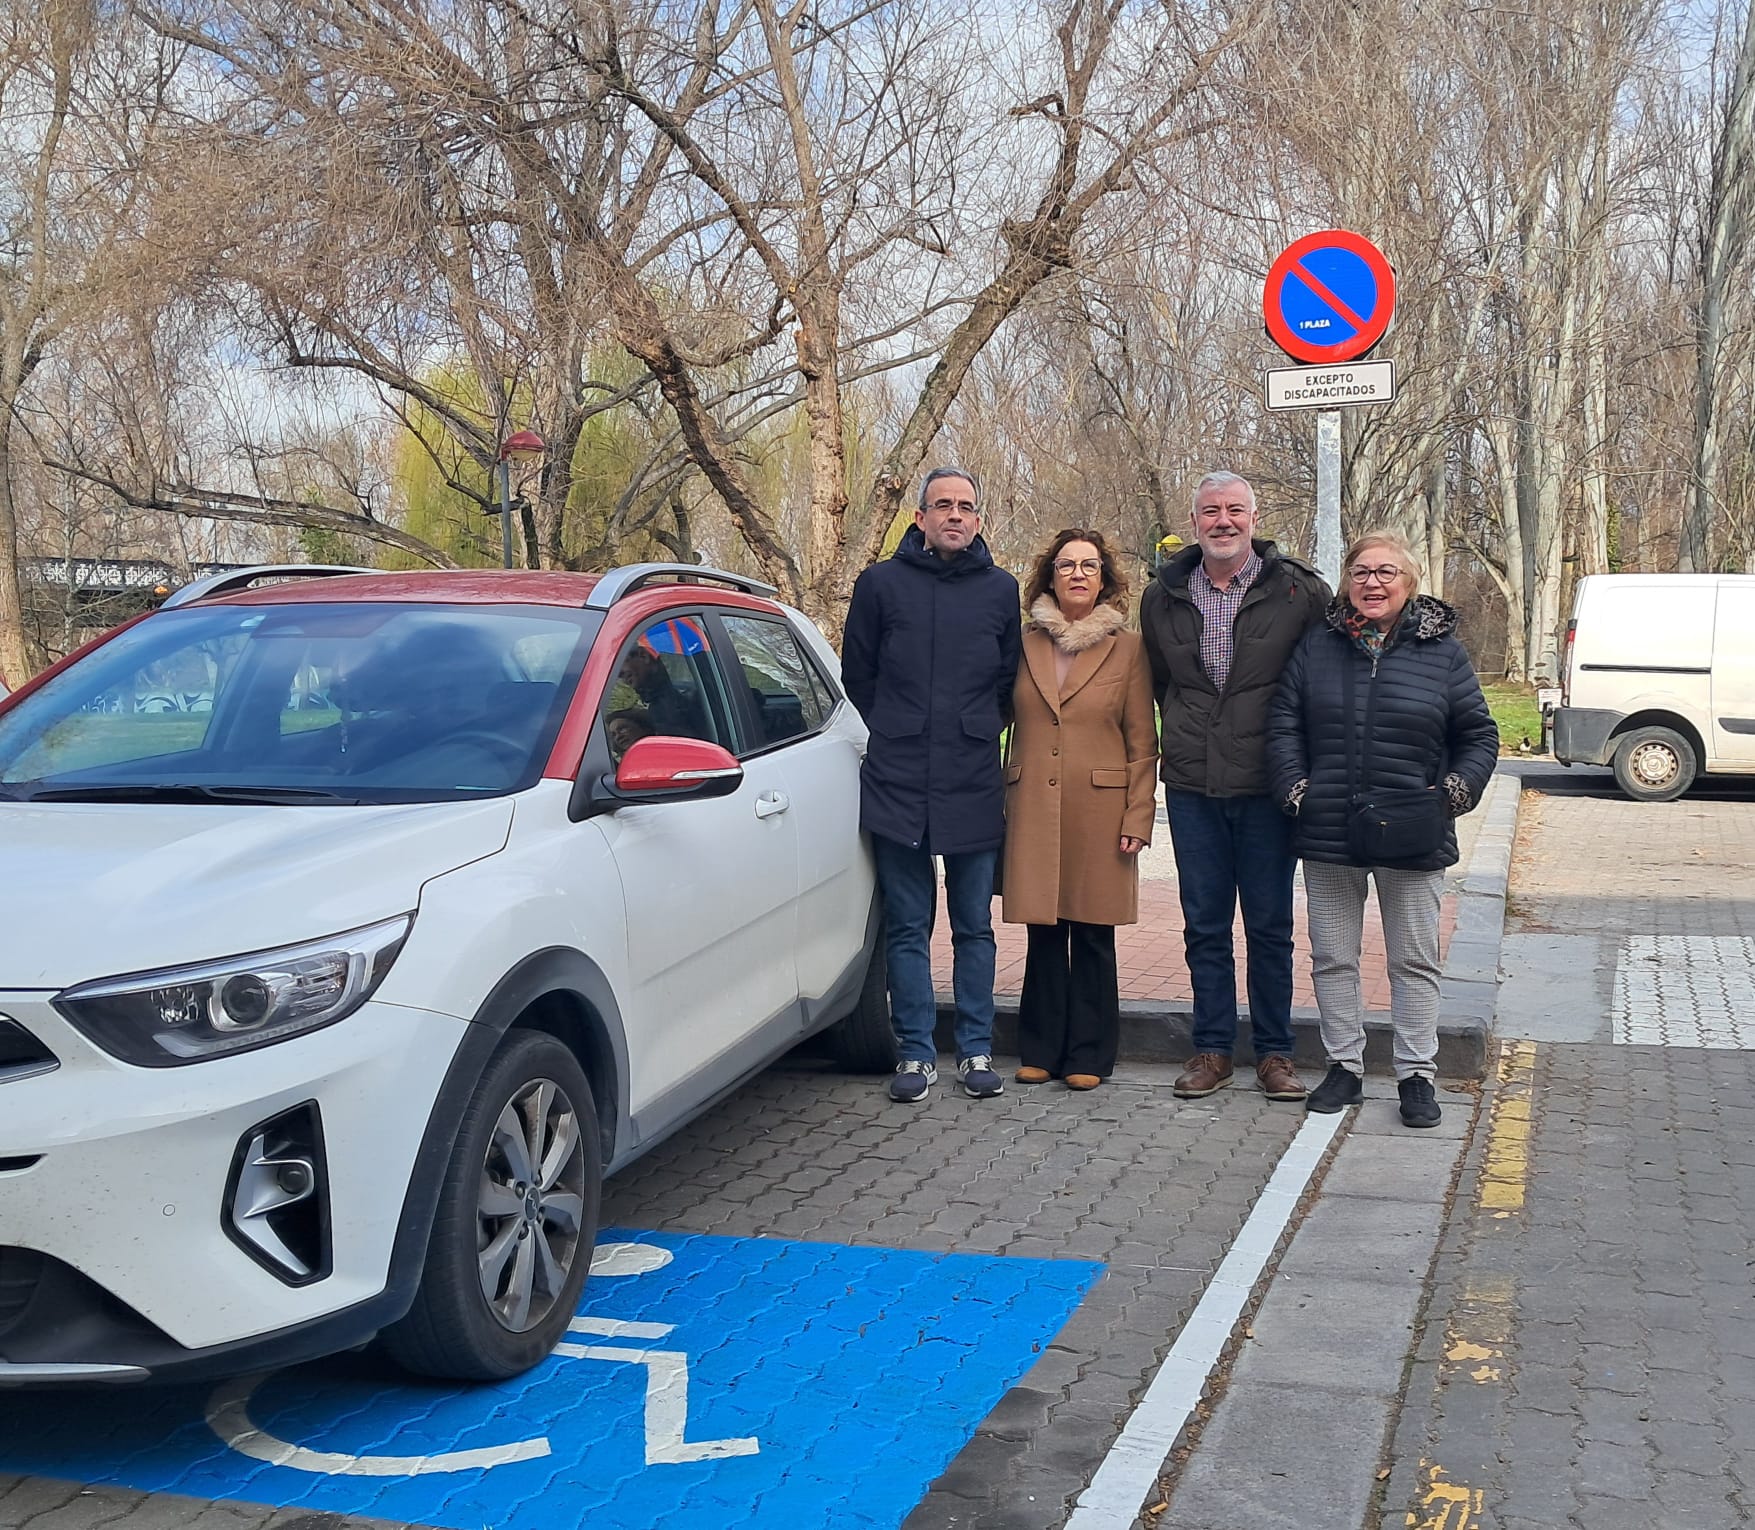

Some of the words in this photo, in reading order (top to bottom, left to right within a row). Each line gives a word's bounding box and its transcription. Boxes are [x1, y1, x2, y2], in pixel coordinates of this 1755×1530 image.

[1305, 319, 1331, 328] PLAZA
[1305, 373, 1354, 386] EXCEPTO
[1284, 384, 1376, 400] DISCAPACITADOS
